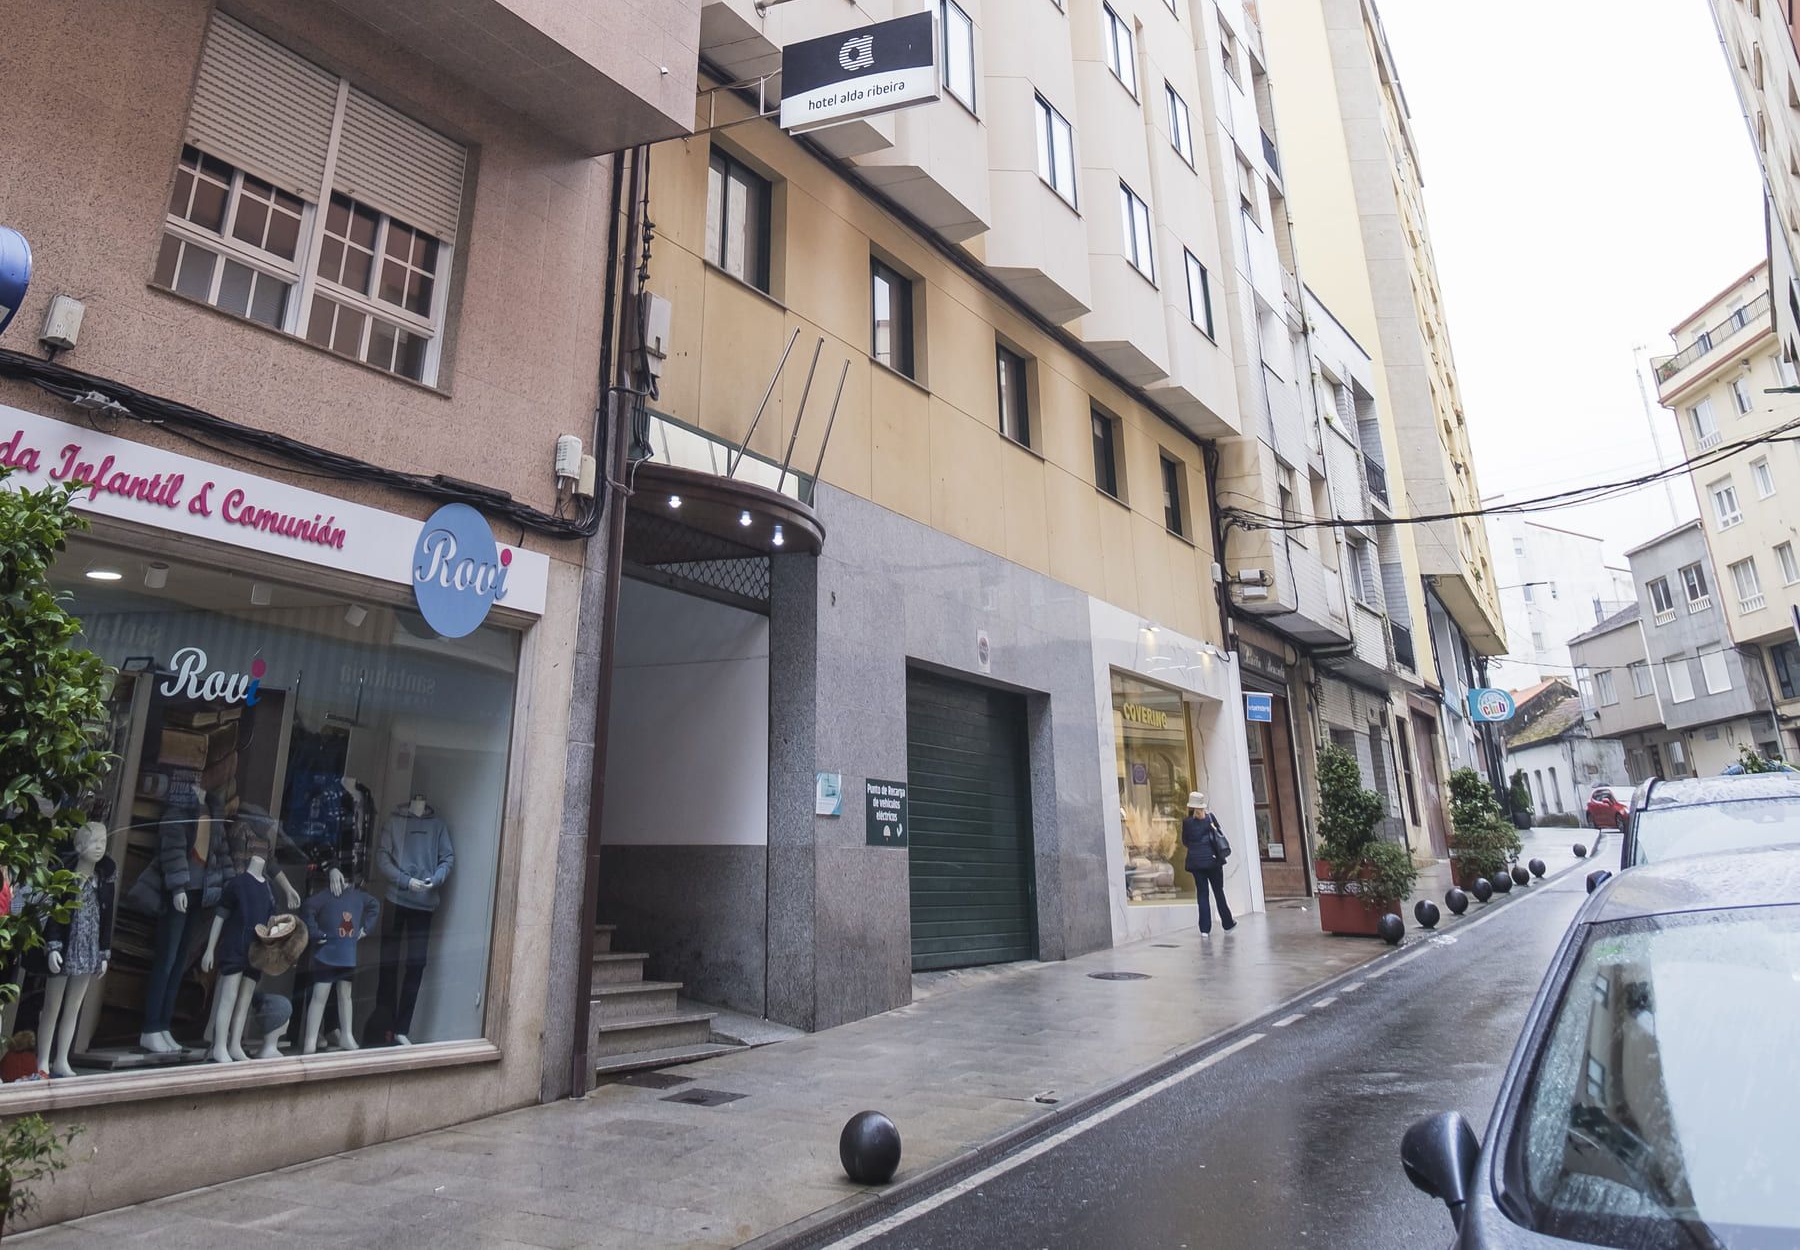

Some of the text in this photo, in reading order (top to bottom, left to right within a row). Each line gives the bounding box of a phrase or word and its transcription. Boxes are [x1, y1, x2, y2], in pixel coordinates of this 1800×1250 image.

[808, 80, 905, 111] hotel alda ribeira
[222, 488, 346, 550] Comunión
[415, 528, 512, 600] Rovi
[160, 647, 267, 707] Rovi
[1123, 702, 1168, 729] COVERING
[1482, 701, 1506, 716] club
[867, 783, 906, 799] Punto de Recarga
[873, 797, 879, 808] de
